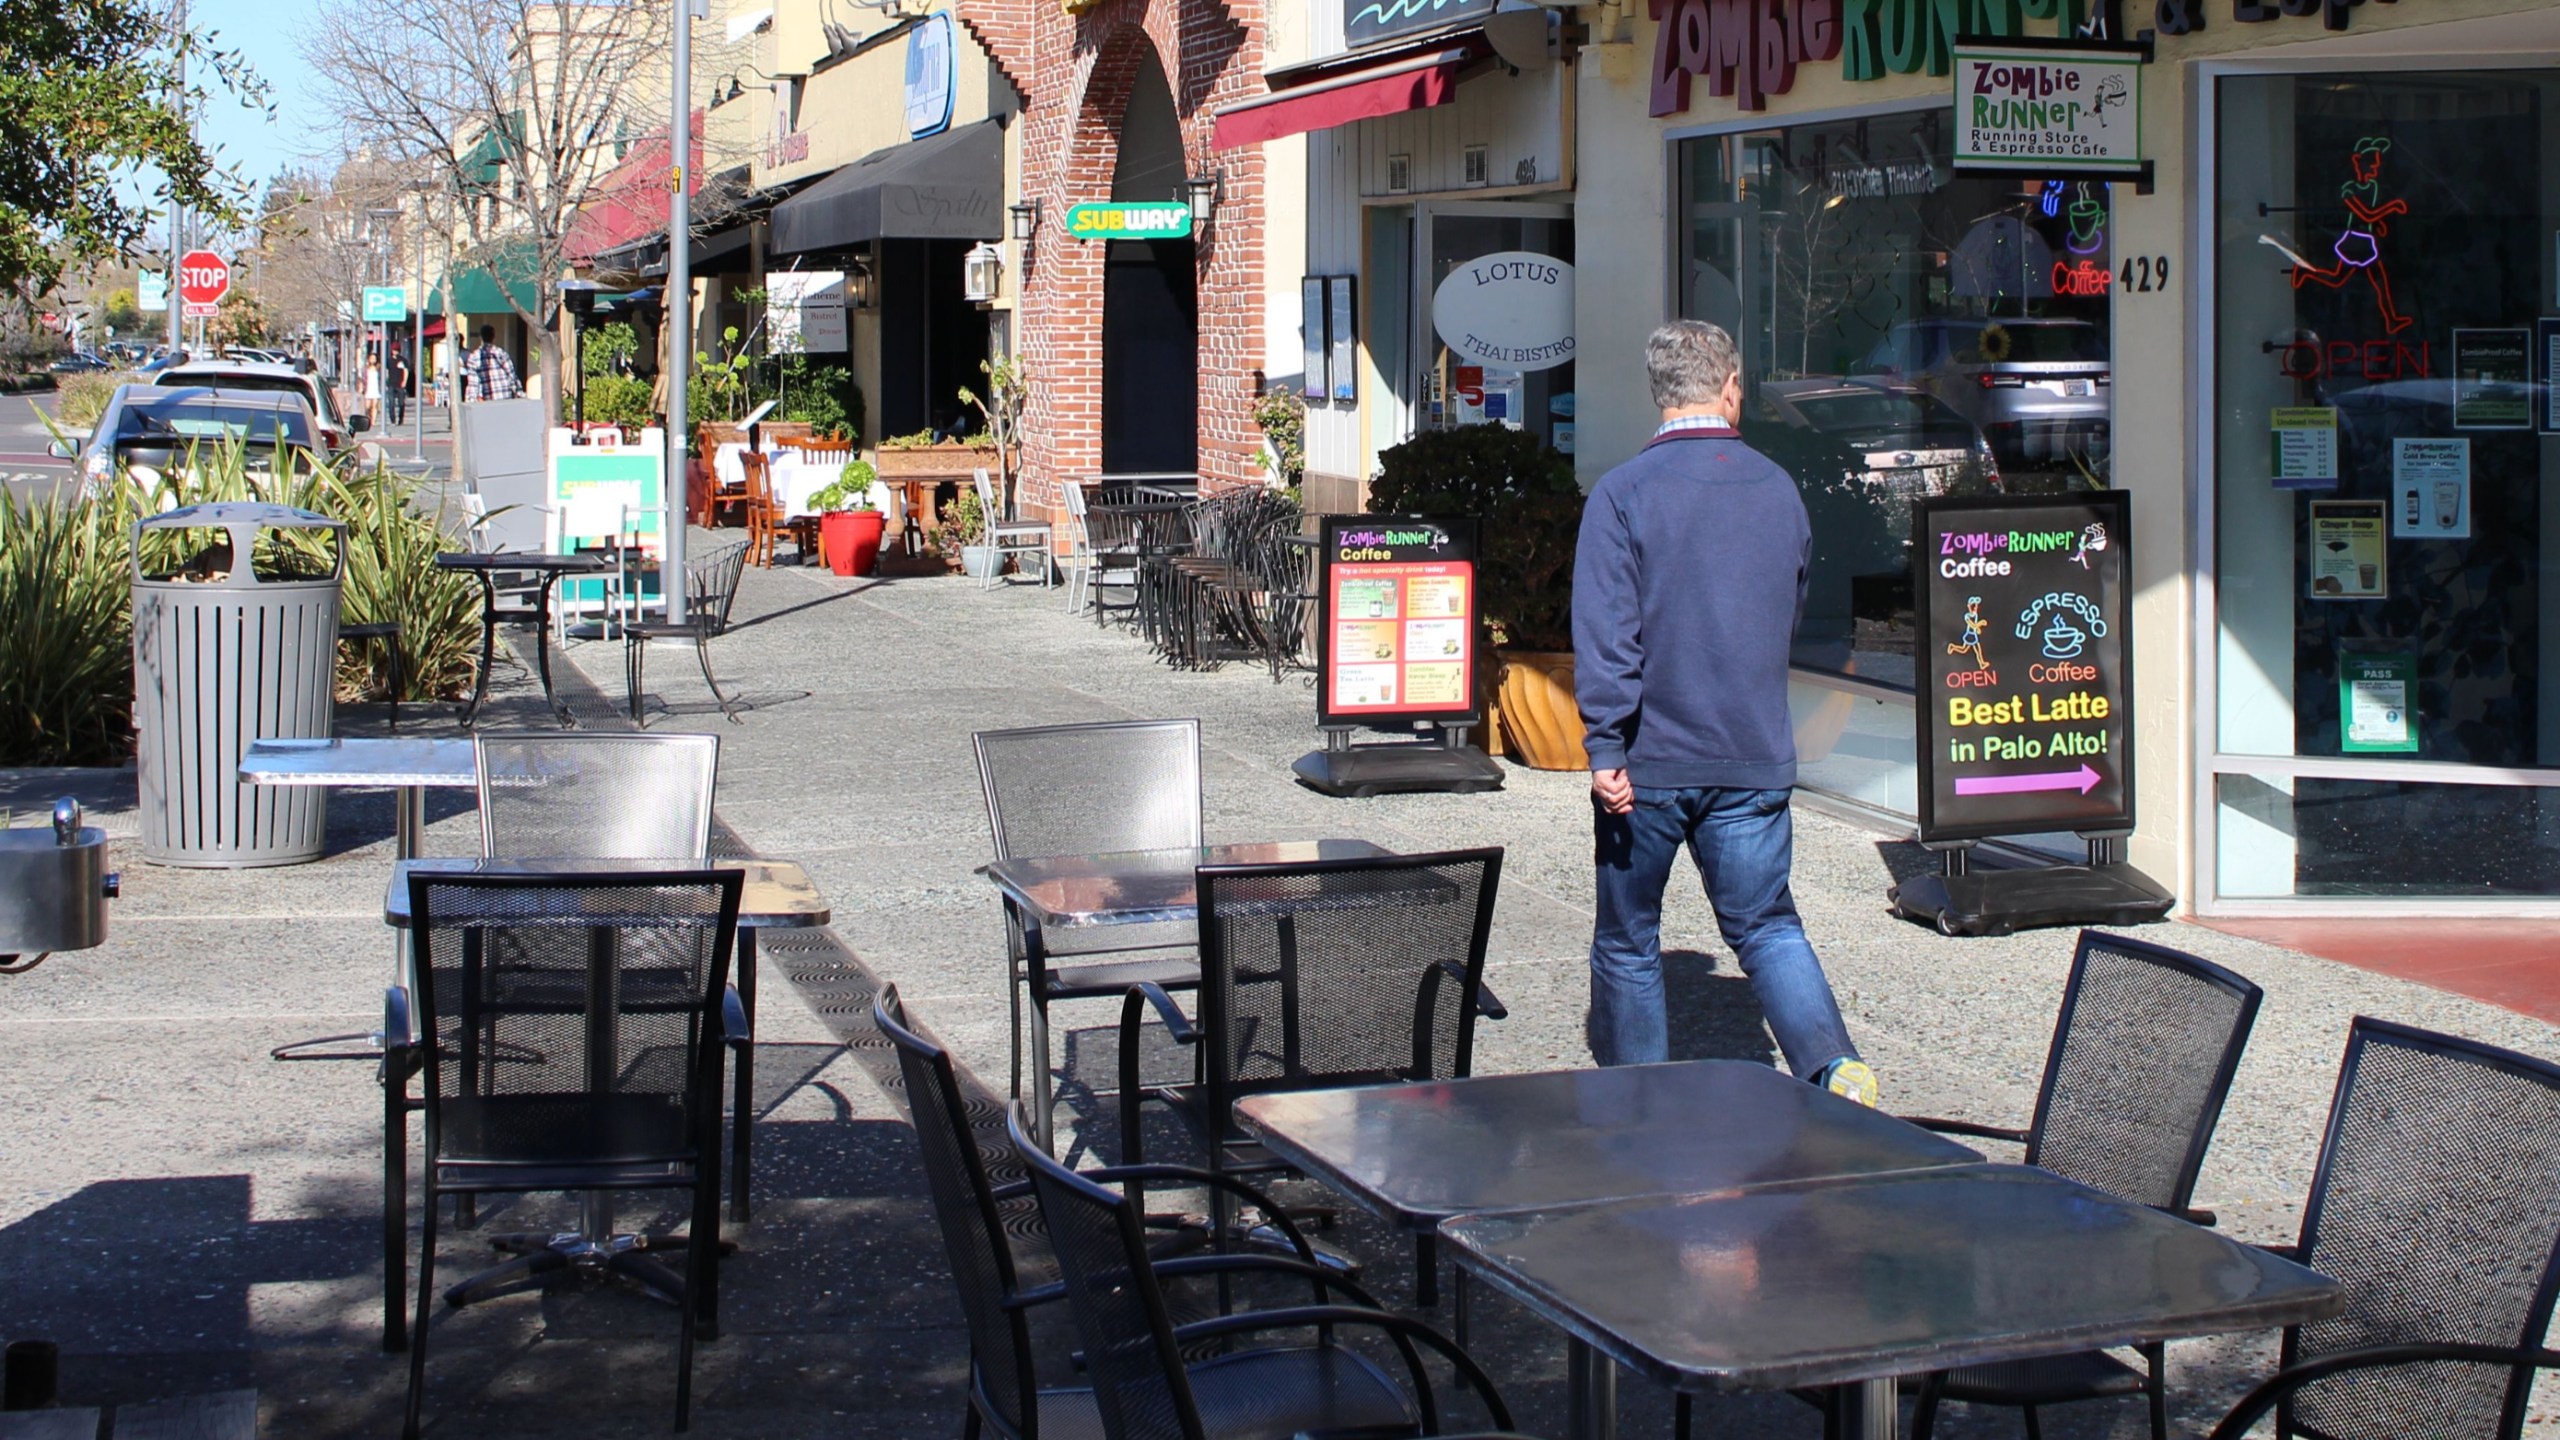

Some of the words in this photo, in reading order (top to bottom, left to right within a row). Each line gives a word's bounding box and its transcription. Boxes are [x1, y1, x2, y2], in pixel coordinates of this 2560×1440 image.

[1971, 129, 2037, 145] Running
[2045, 131, 2088, 144] Store
[1971, 141, 1981, 152] &
[1989, 141, 2064, 155] Espresso
[2071, 143, 2108, 155] Cafe
[1073, 207, 1188, 232] SUBWAY
[182, 267, 226, 288] STOP
[1472, 262, 1560, 287] LOTUS
[2052, 260, 2113, 294] Coffee
[2120, 256, 2168, 292] 429
[1463, 333, 1509, 362] THAI
[1513, 336, 1575, 362] BISTRO
[2283, 340, 2430, 380] OPEN
[2320, 520, 2349, 530] Ginger
[2351, 520, 2374, 530] Snap
[1340, 548, 1392, 561] Coffee
[1405, 565, 1424, 573] drink
[1940, 557, 2012, 579] Coffee
[2015, 592, 2108, 640] ESPRESSO
[1946, 670, 1998, 689] OPEN
[2028, 662, 2098, 685] Coffee
[2363, 669, 2393, 679] PASS
[1949, 695, 2025, 727] Best
[2031, 691, 2110, 722] Latte
[1950, 738, 1976, 763] in
[1983, 734, 2042, 761] Palo
[2048, 730, 2108, 758] Alto!
